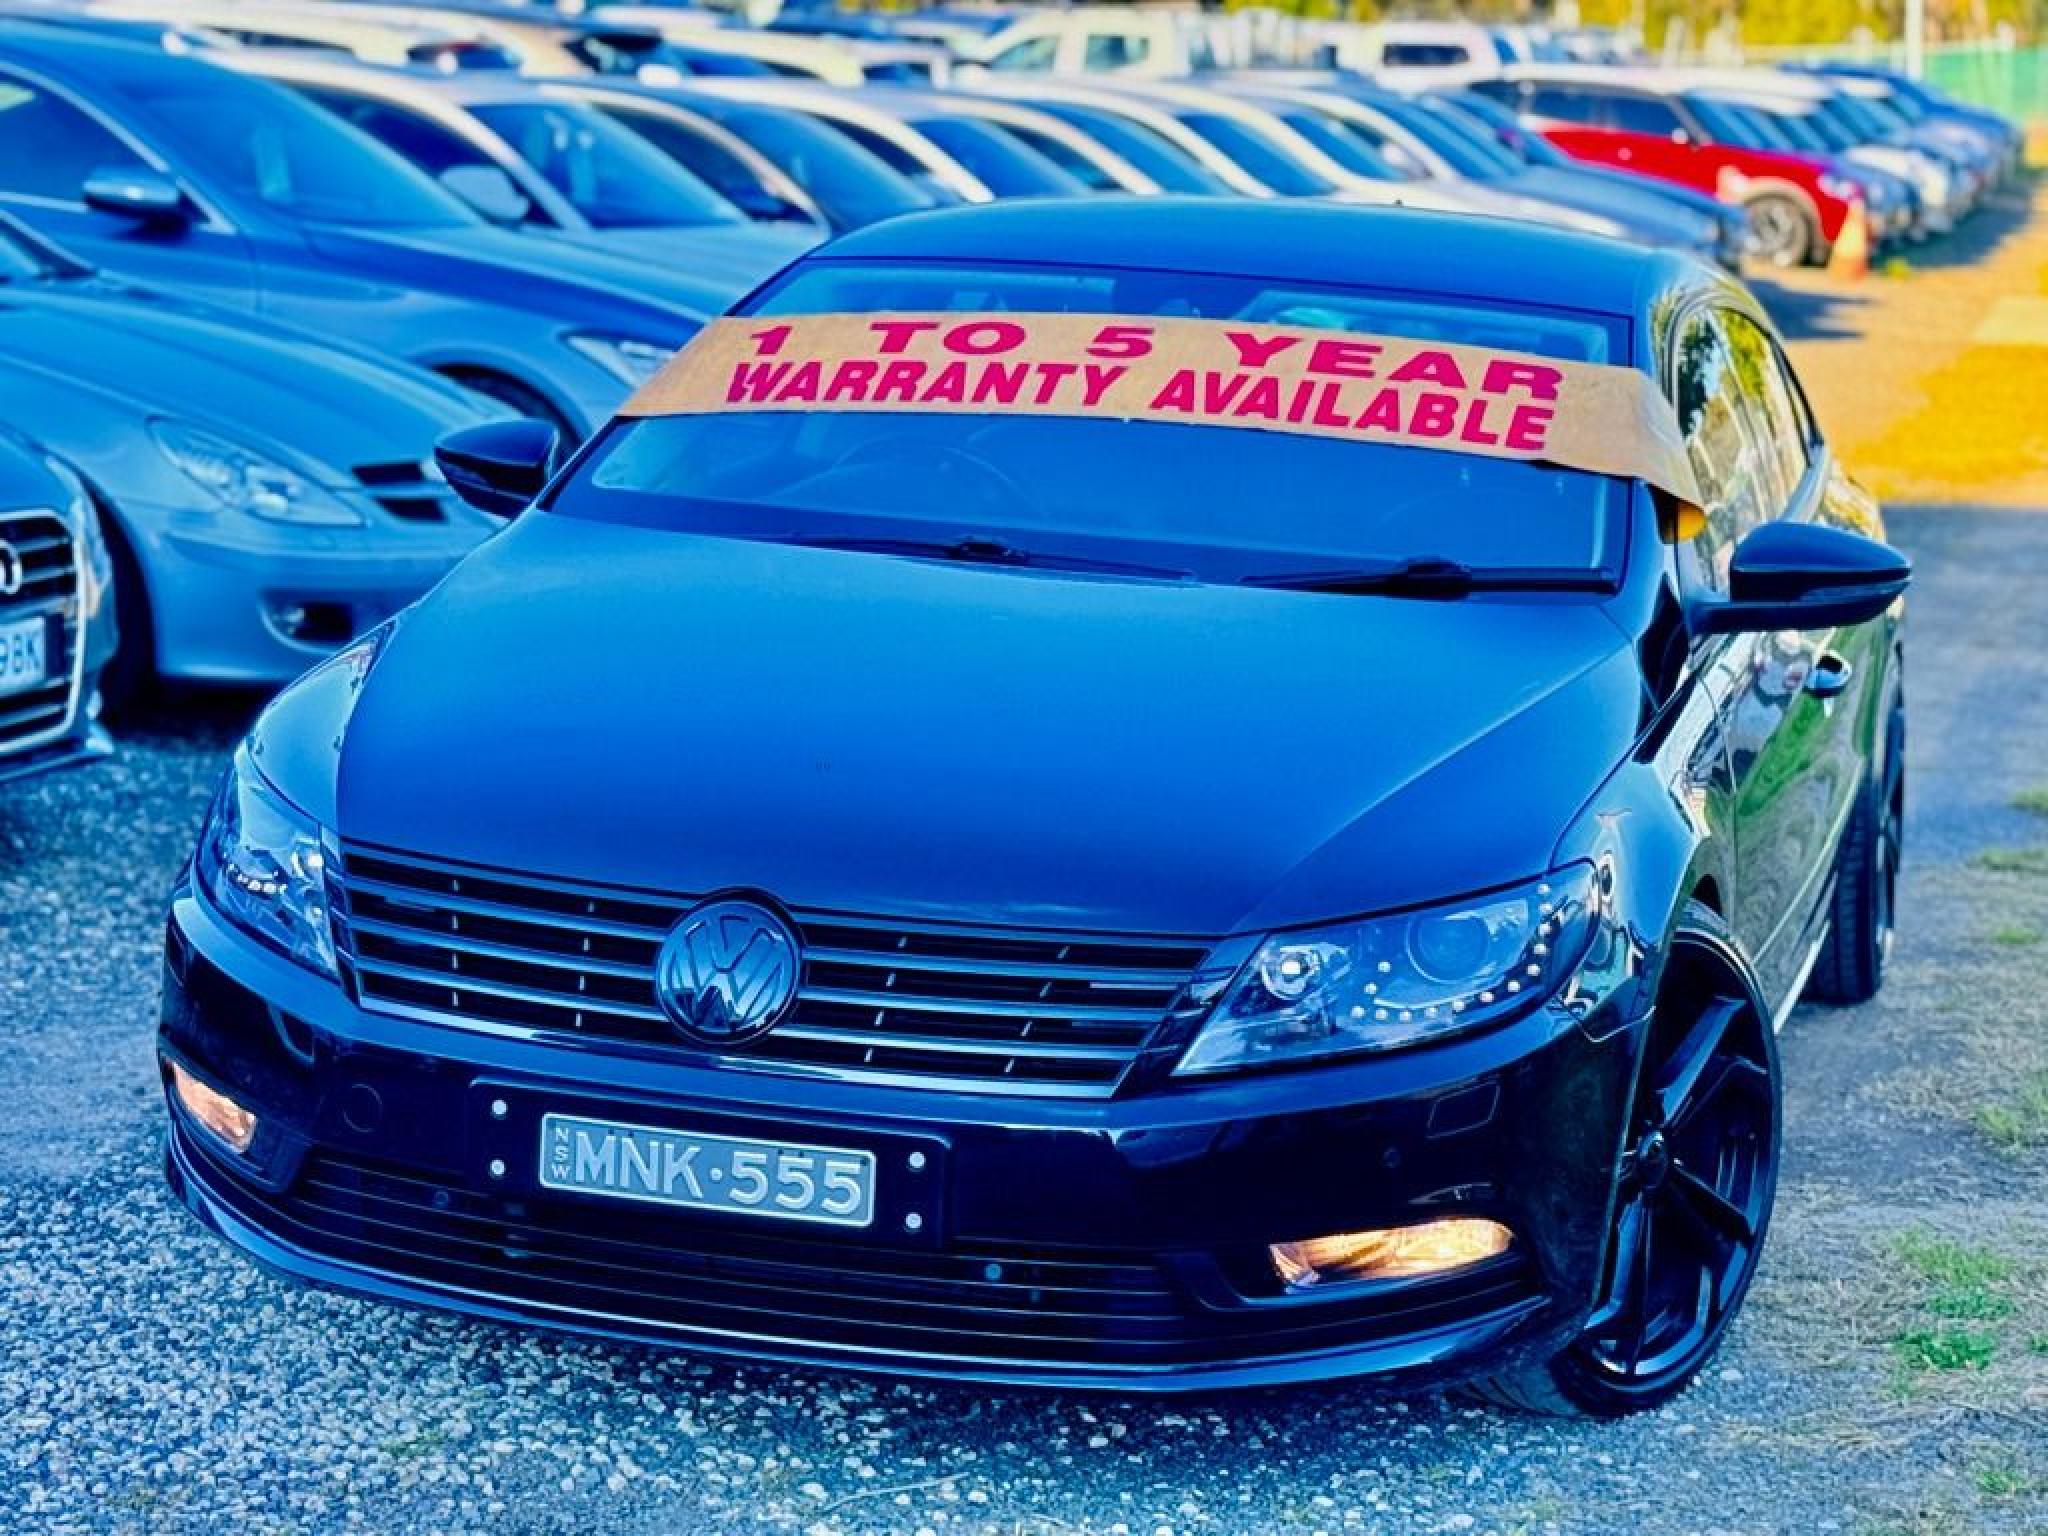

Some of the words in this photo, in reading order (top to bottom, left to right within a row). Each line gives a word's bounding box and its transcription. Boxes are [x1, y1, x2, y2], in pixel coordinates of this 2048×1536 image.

[751, 325, 793, 355] 1
[869, 321, 1026, 355] TO
[1085, 326, 1155, 358] 5
[1225, 331, 1563, 401] YEAR
[726, 361, 1128, 406] WARRANTY
[1150, 369, 1555, 450] AVAILABLE
[551, 1127, 570, 1179] NSW
